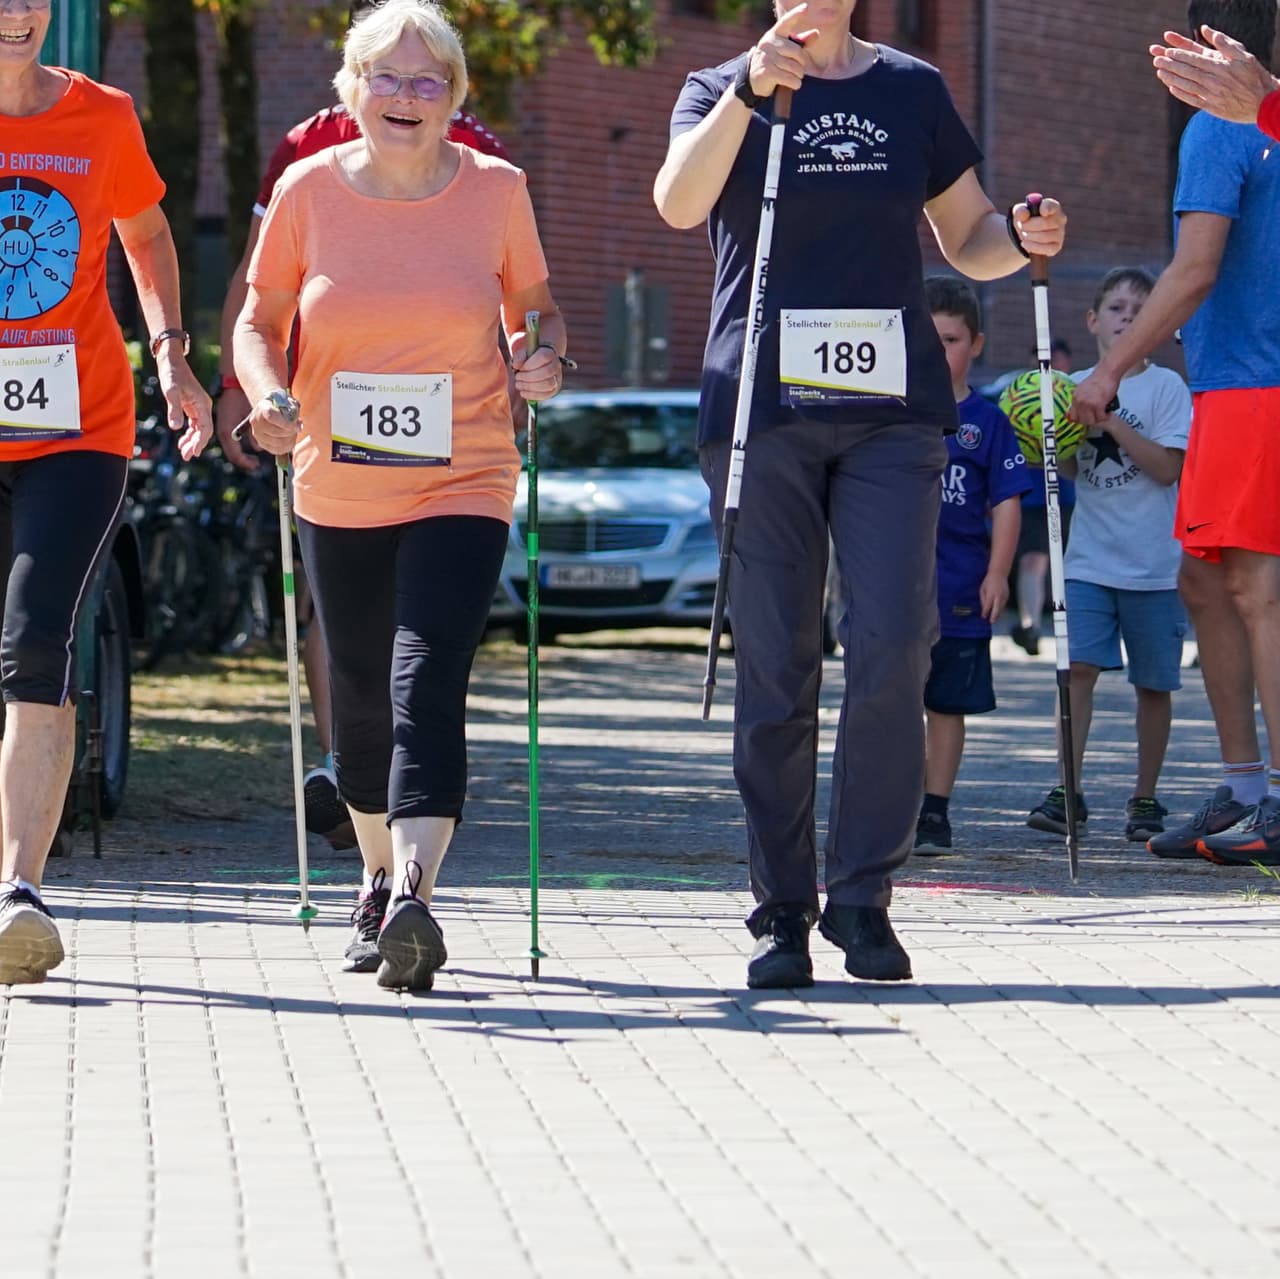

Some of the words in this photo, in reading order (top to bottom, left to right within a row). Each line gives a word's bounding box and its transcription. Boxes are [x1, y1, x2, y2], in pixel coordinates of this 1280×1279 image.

[792, 112, 889, 145] MUSTANG
[809, 128, 846, 147] ORIGINAL
[847, 128, 875, 147] BRAND
[10, 153, 91, 175] ENTSPRICHT
[797, 164, 833, 173] JEANS
[835, 162, 889, 172] COMPANY
[10, 194, 25, 211] 12
[32, 200, 48, 219] 11
[47, 219, 66, 238] 10
[4, 240, 29, 256] HU
[43, 267, 59, 282] 8
[787, 319, 832, 329] Stellichter
[834, 319, 882, 329] Straßenlauf
[2, 356, 51, 366] Straßenlauf
[813, 341, 877, 375] 189
[336, 381, 376, 392] Stellichter
[377, 383, 428, 393] Straßenlauf
[359, 404, 422, 438] 183
[1083, 467, 1100, 488] ALL
[1105, 464, 1142, 489] STAR
